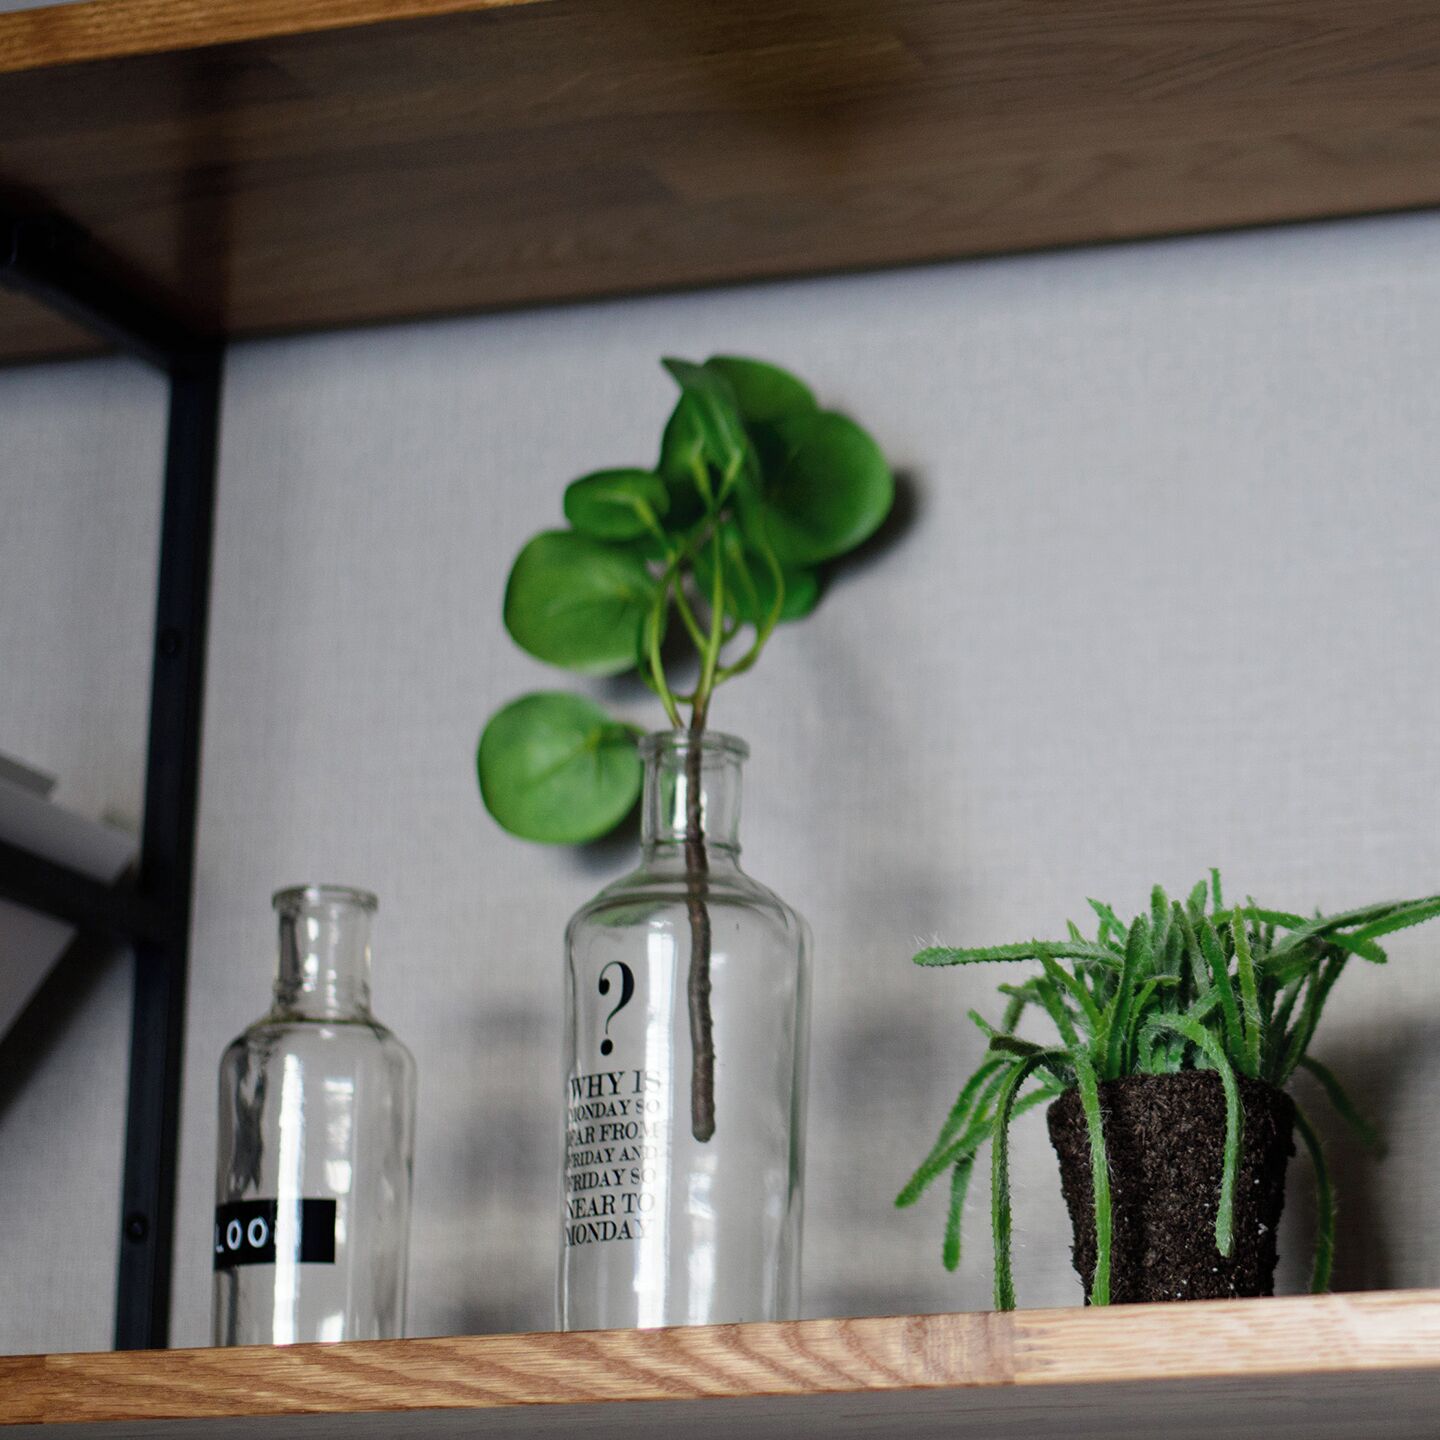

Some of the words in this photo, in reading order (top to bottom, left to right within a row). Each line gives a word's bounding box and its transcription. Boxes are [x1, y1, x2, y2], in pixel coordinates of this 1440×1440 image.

[598, 961, 635, 1056] ?
[571, 1071, 626, 1100] WHY
[632, 1070, 662, 1093] IS
[621, 1192, 655, 1214] TO
